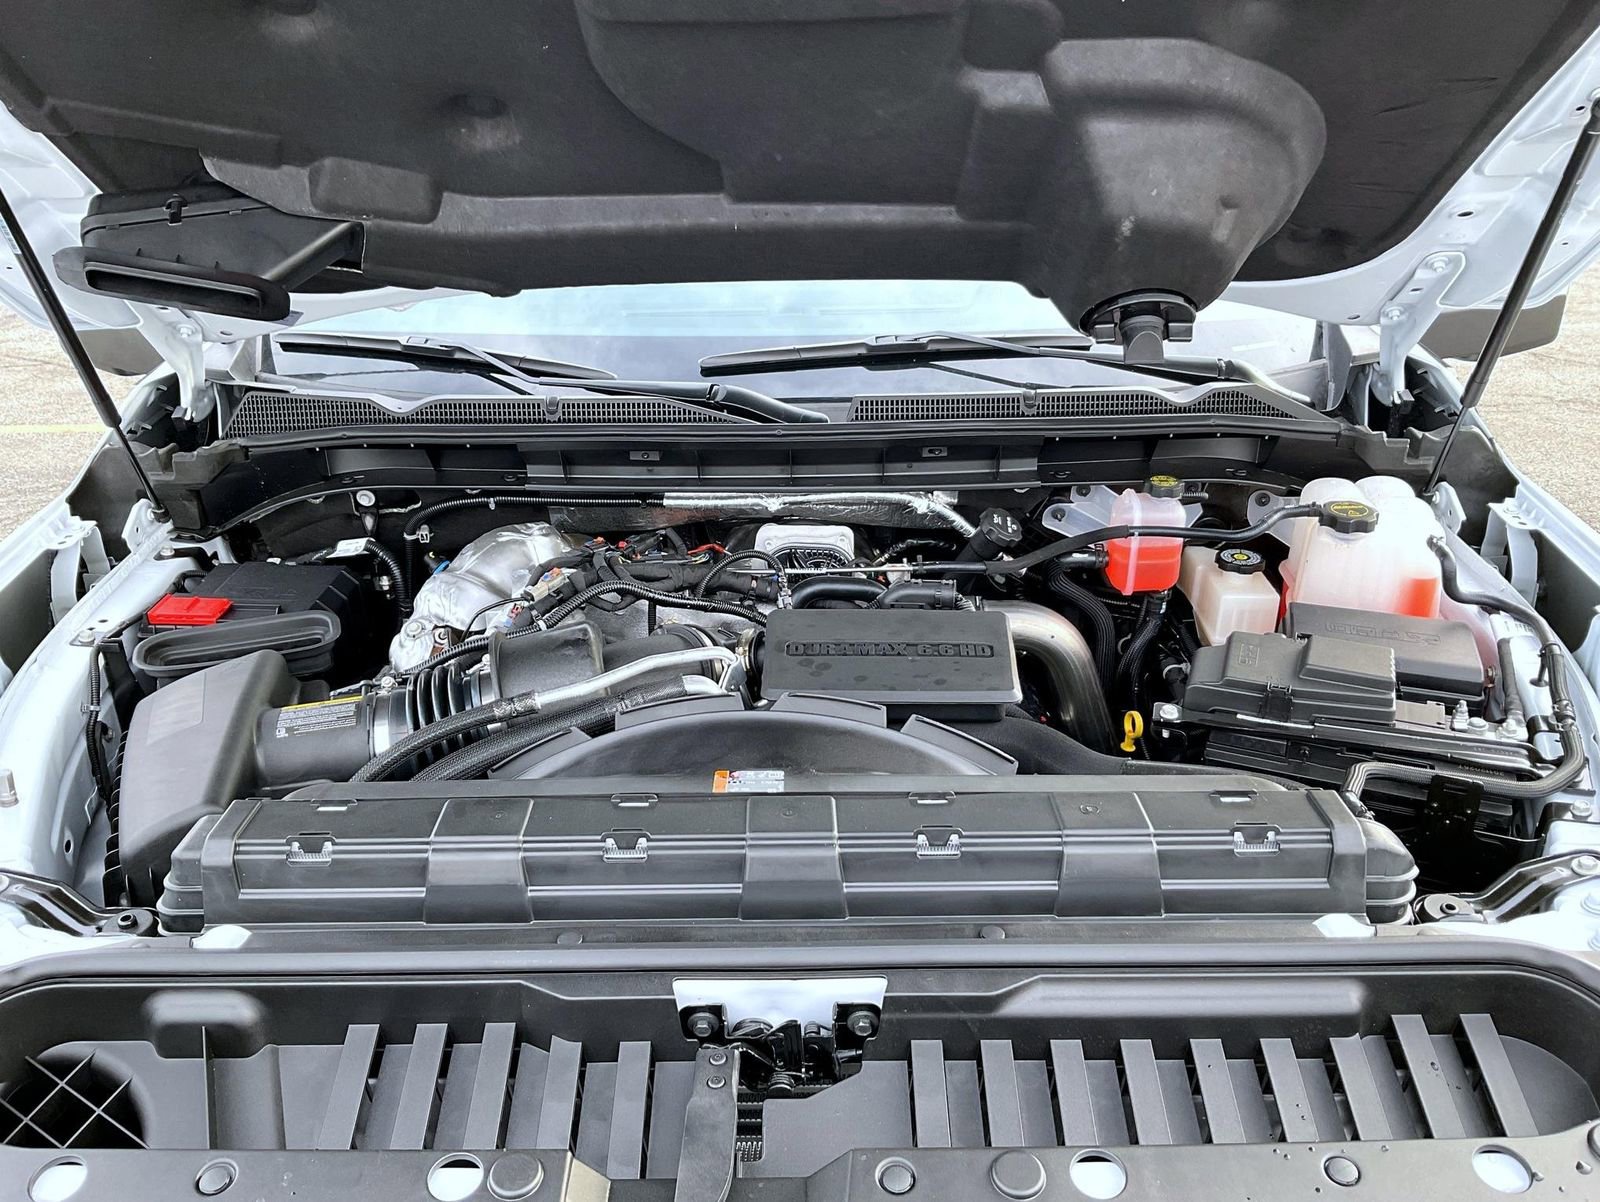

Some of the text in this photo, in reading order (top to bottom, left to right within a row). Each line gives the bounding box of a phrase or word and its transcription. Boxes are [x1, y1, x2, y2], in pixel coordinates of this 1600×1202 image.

[789, 644, 991, 657] DURAMAX 6.6 HD
